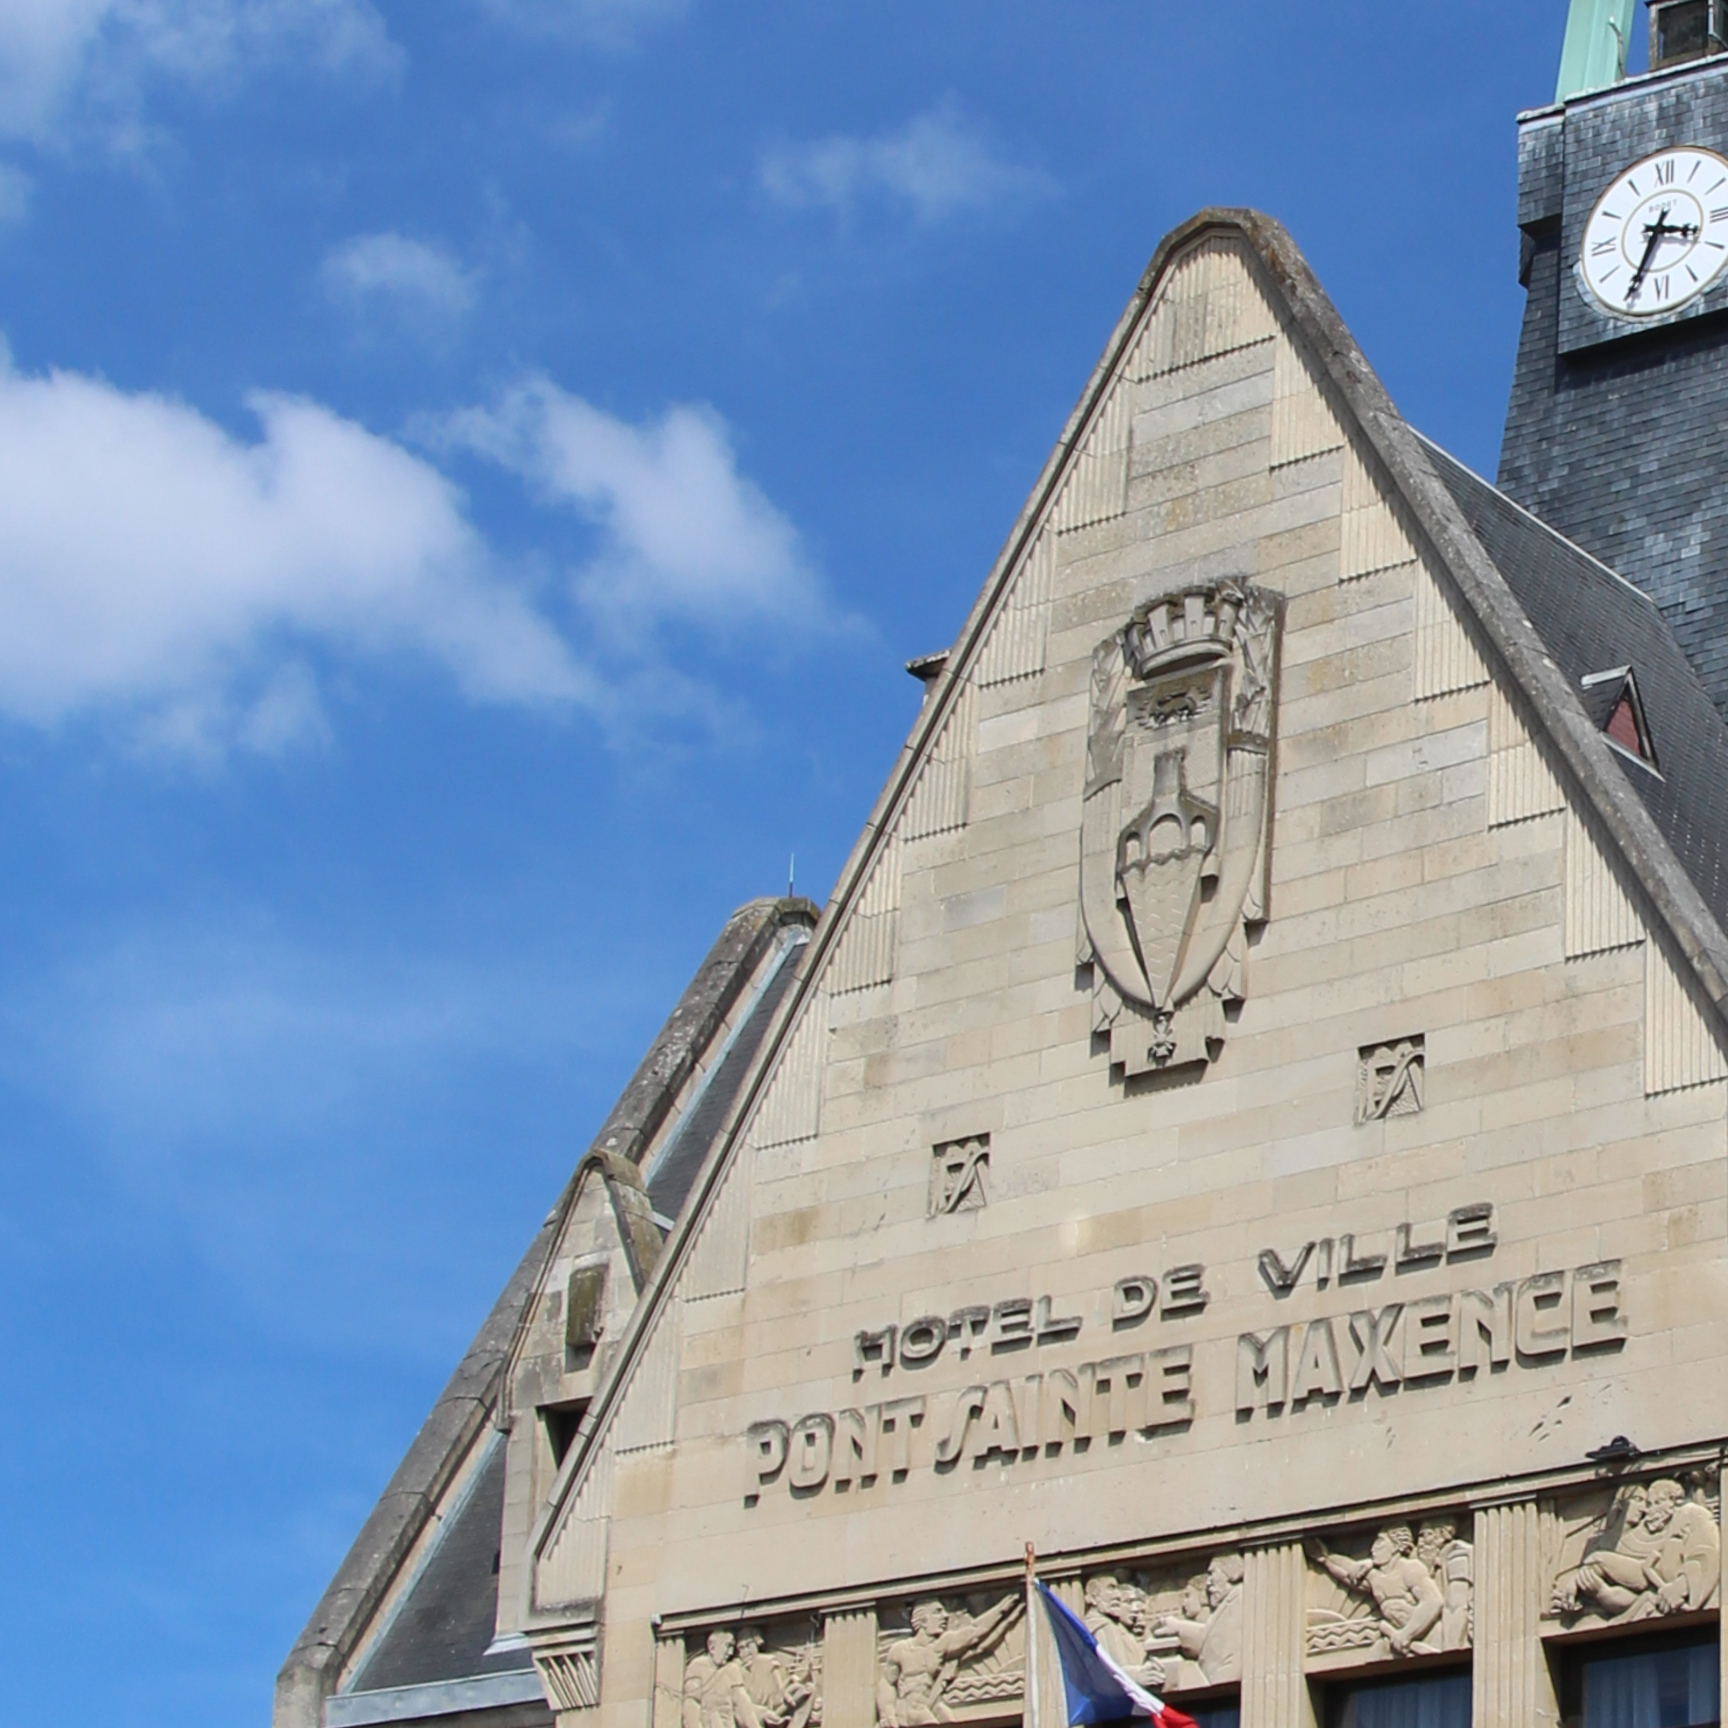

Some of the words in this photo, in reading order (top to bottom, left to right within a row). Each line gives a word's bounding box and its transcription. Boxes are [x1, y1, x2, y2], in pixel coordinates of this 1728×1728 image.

[1654, 159, 1674, 187] XII
[853, 1295, 1083, 1382] HOTEL
[1112, 1264, 1210, 1332] DE
[1258, 1202, 1498, 1300] VILLE
[744, 1396, 926, 1508] PONT
[934, 1344, 1196, 1474] SAINTE
[1235, 1259, 1628, 1424] MAXENCE
